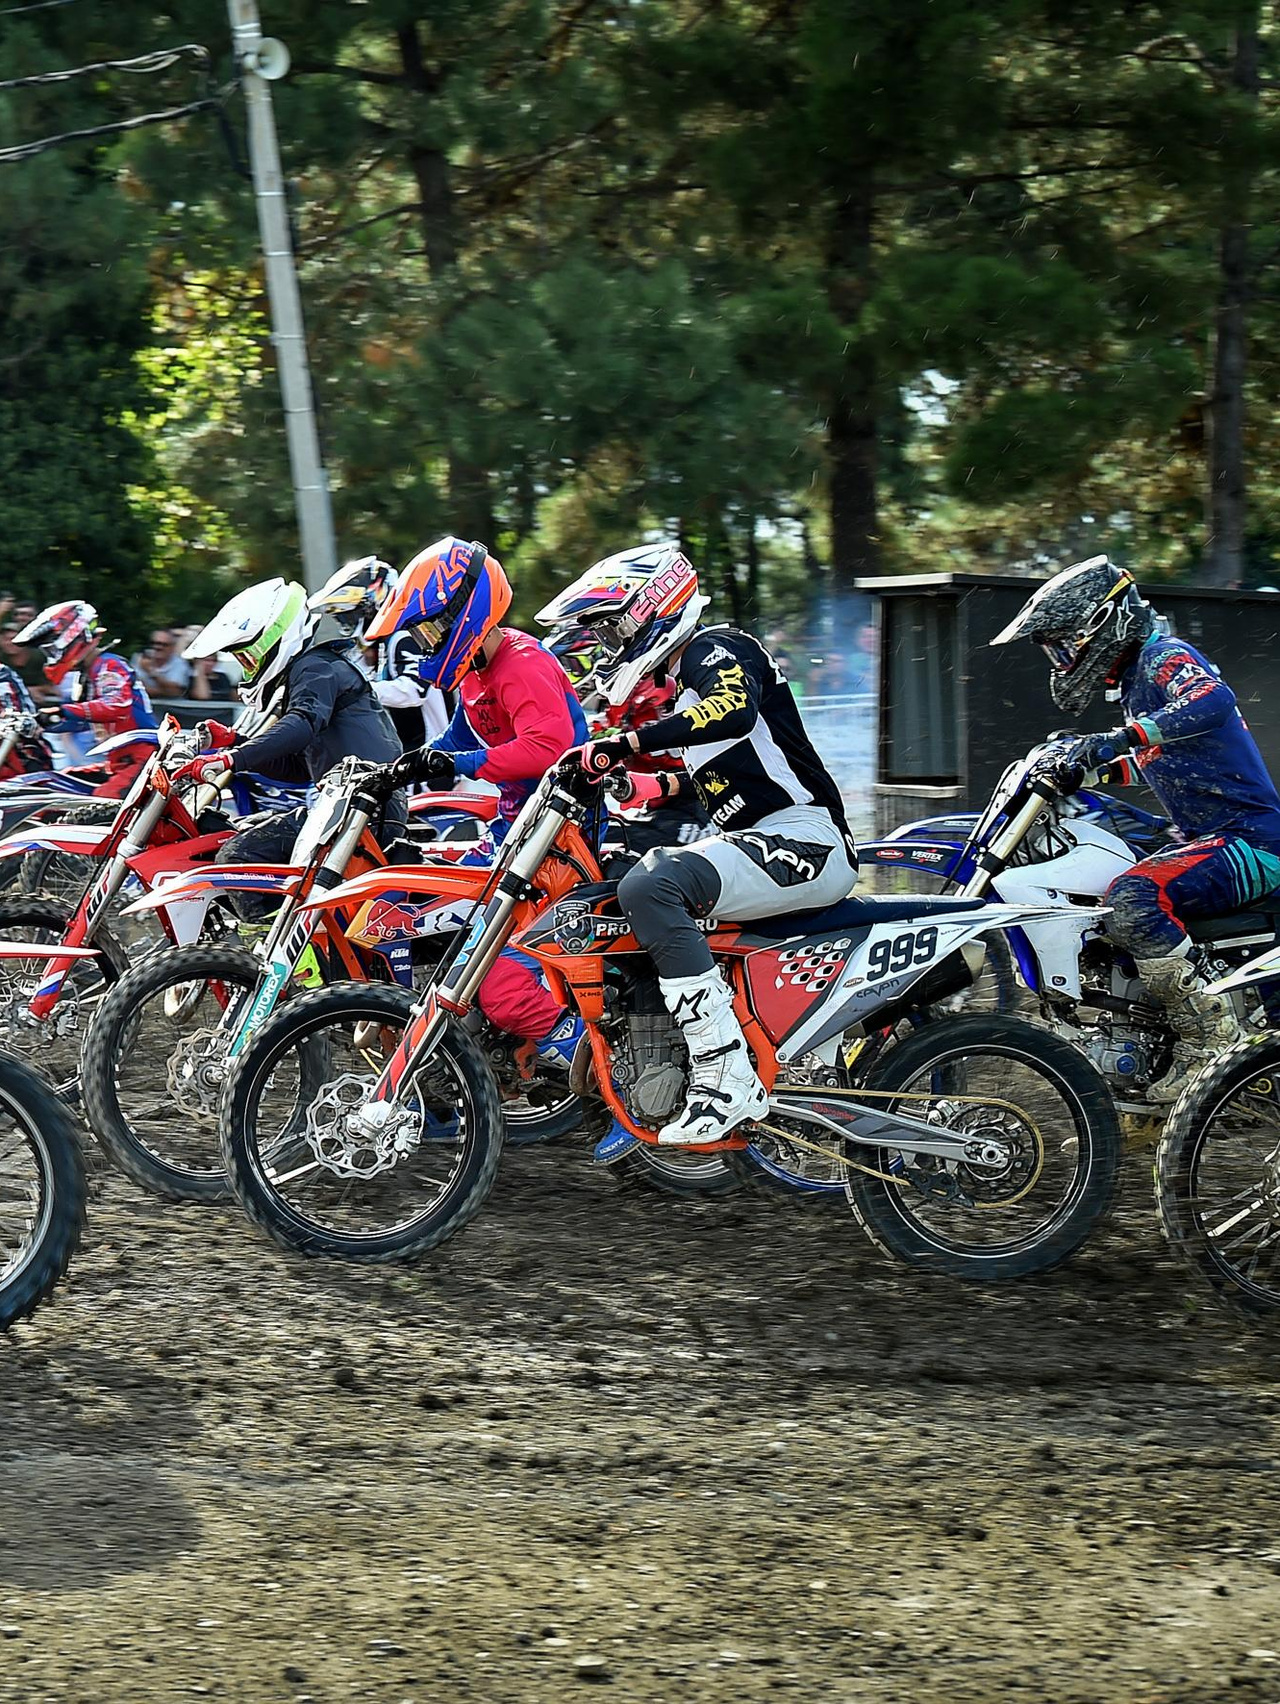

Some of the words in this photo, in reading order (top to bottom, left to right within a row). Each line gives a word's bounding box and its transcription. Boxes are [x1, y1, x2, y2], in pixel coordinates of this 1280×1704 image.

[711, 793, 747, 826] TEAM
[911, 850, 944, 861] VERTEX
[866, 926, 939, 982] 999
[249, 972, 282, 1031] MOTOREX
